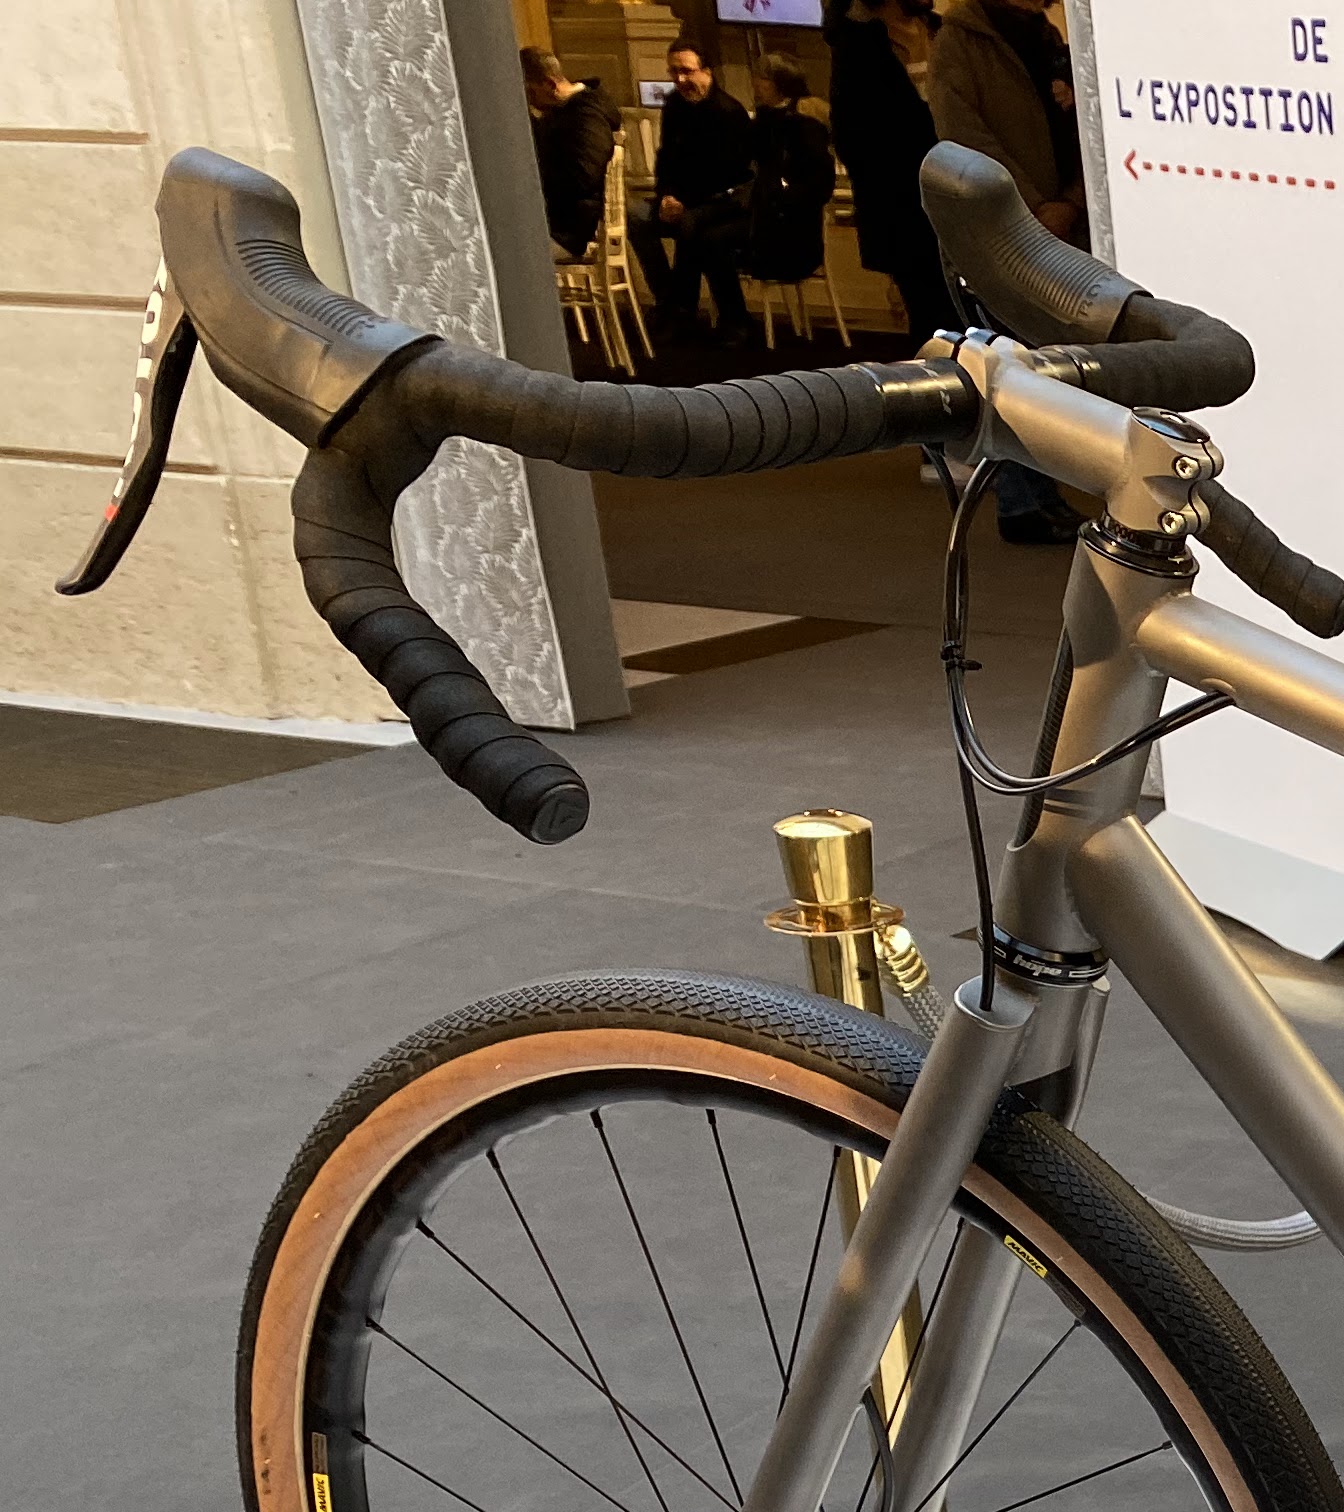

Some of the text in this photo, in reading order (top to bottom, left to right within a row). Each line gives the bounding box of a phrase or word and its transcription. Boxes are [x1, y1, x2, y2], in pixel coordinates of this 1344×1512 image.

[1291, 17, 1328, 63] DE
[1115, 77, 1334, 136] L'EXPOSITION
[1013, 953, 1062, 977] hope
[1007, 1241, 1045, 1272] MAVIC
